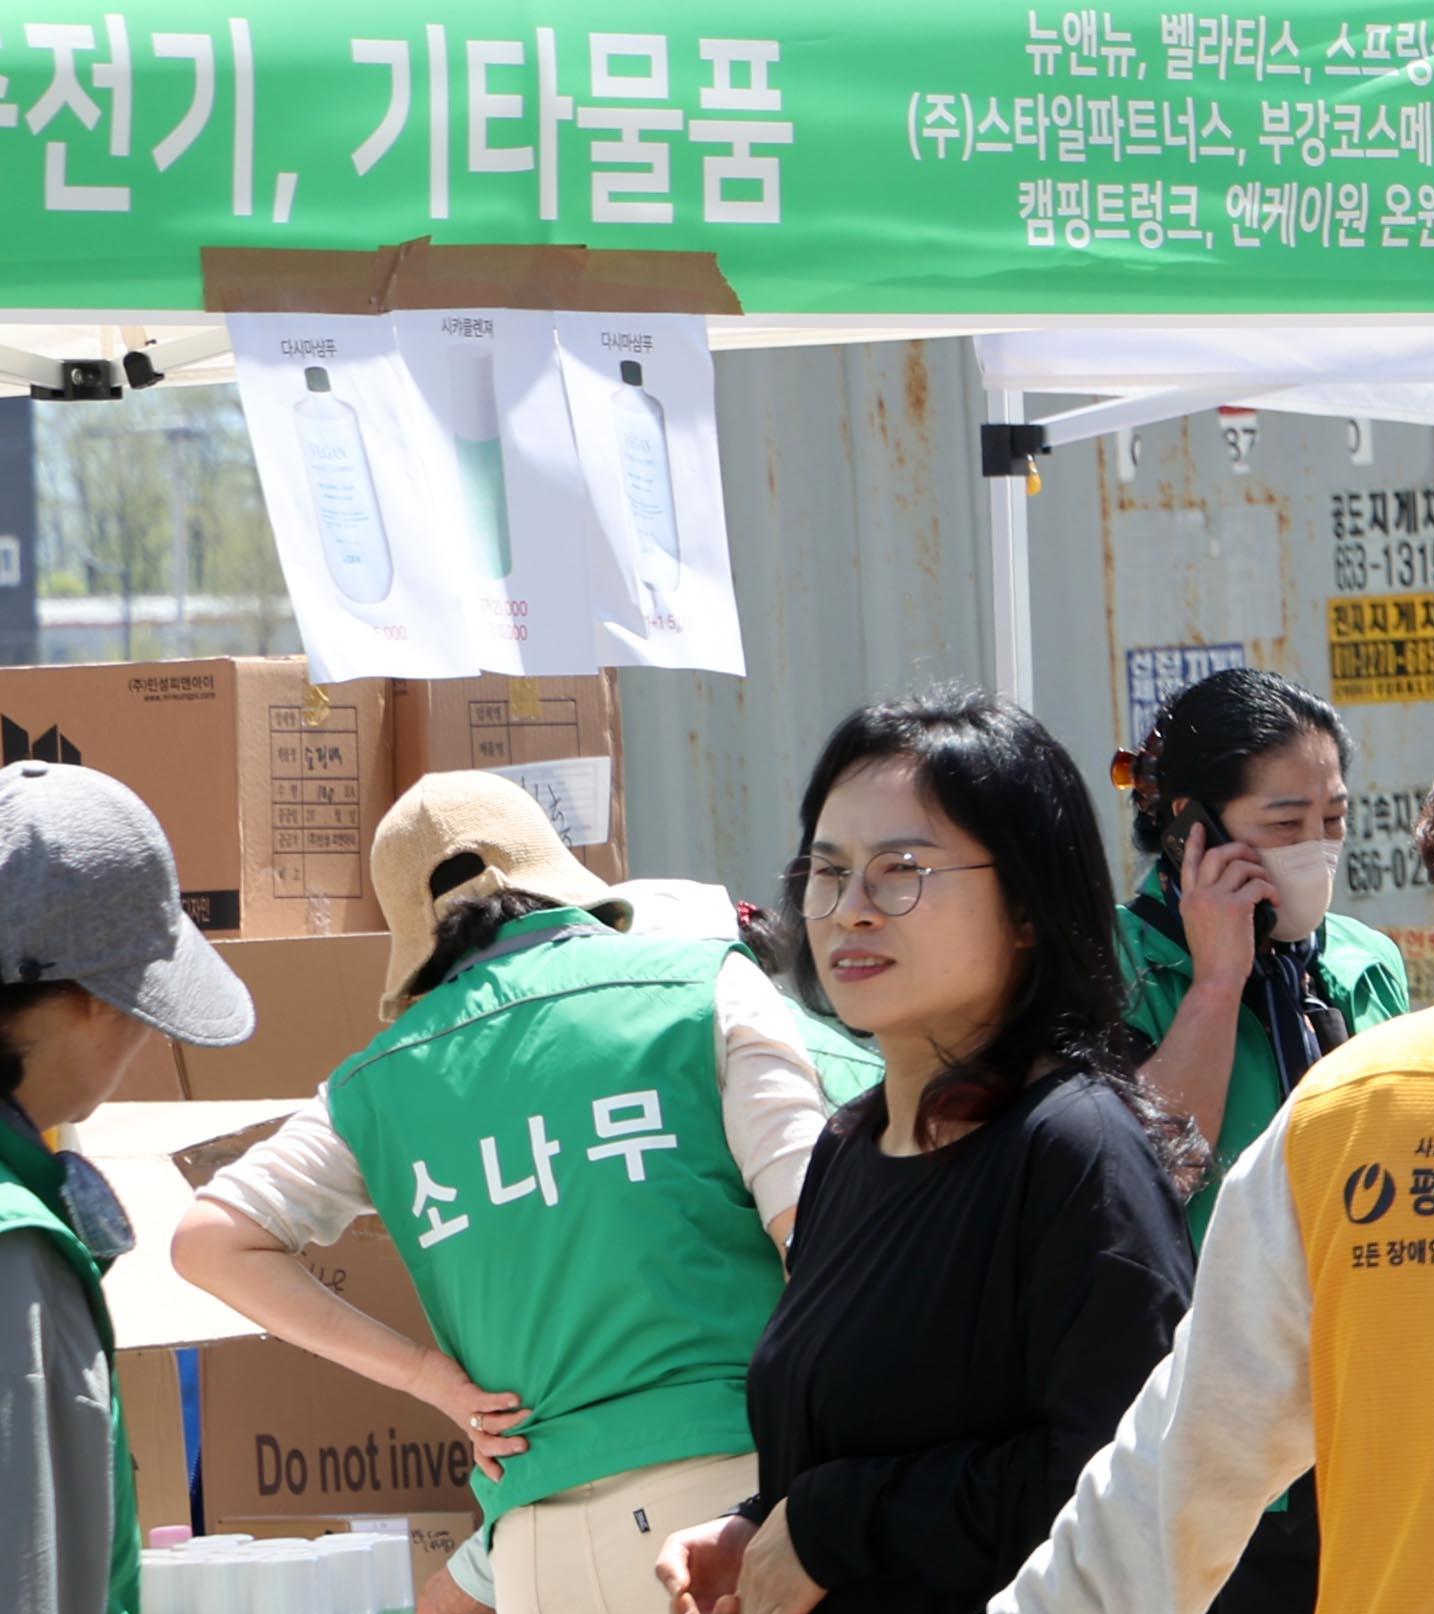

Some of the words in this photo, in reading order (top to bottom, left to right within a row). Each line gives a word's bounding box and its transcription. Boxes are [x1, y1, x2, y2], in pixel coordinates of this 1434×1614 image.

[1024, 9, 1147, 80] 뉴앤뉴,
[1160, 12, 1312, 84] 벨라티스,
[351, 23, 794, 225] 기타물품
[907, 90, 1247, 166] (주)스타일파트너스,
[1017, 179, 1215, 250] 캠핑트렁크,
[1225, 180, 1370, 250] 엔케이원
[410, 1088, 678, 1250] 소나무
[1351, 1244, 1382, 1268] 모든
[255, 1433, 308, 1496] Do
[319, 1431, 381, 1493] not
[387, 1427, 472, 1488] inve
